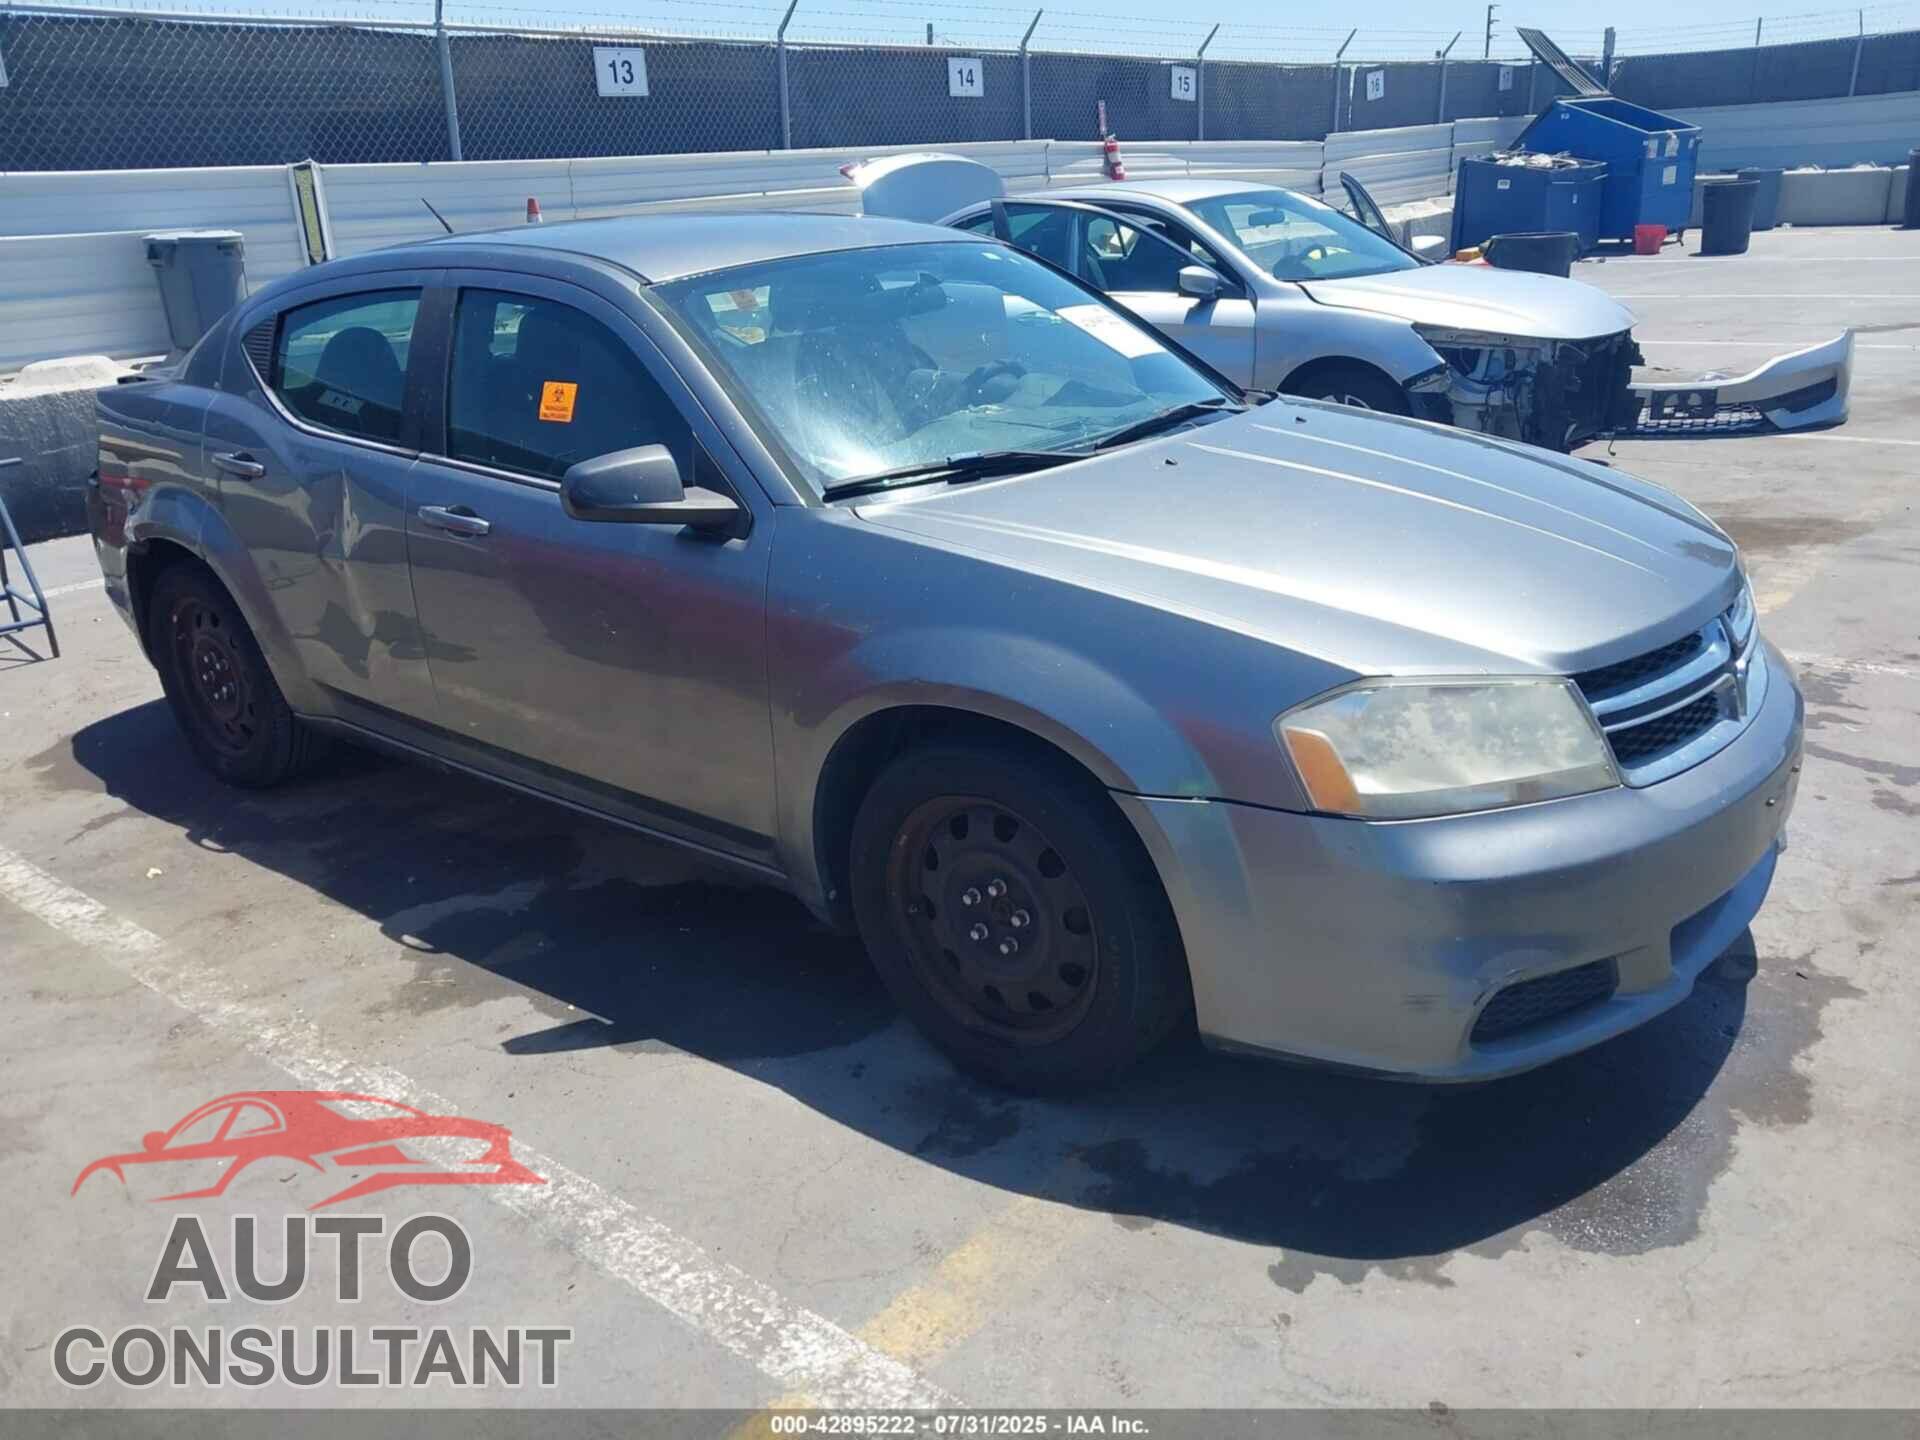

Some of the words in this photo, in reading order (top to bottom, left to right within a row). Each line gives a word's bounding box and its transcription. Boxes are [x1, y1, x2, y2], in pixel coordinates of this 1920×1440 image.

[608, 59, 634, 84] 13
[957, 68, 975, 87] 14
[1178, 75, 1190, 92] 15
[1370, 78, 1381, 93] 16
